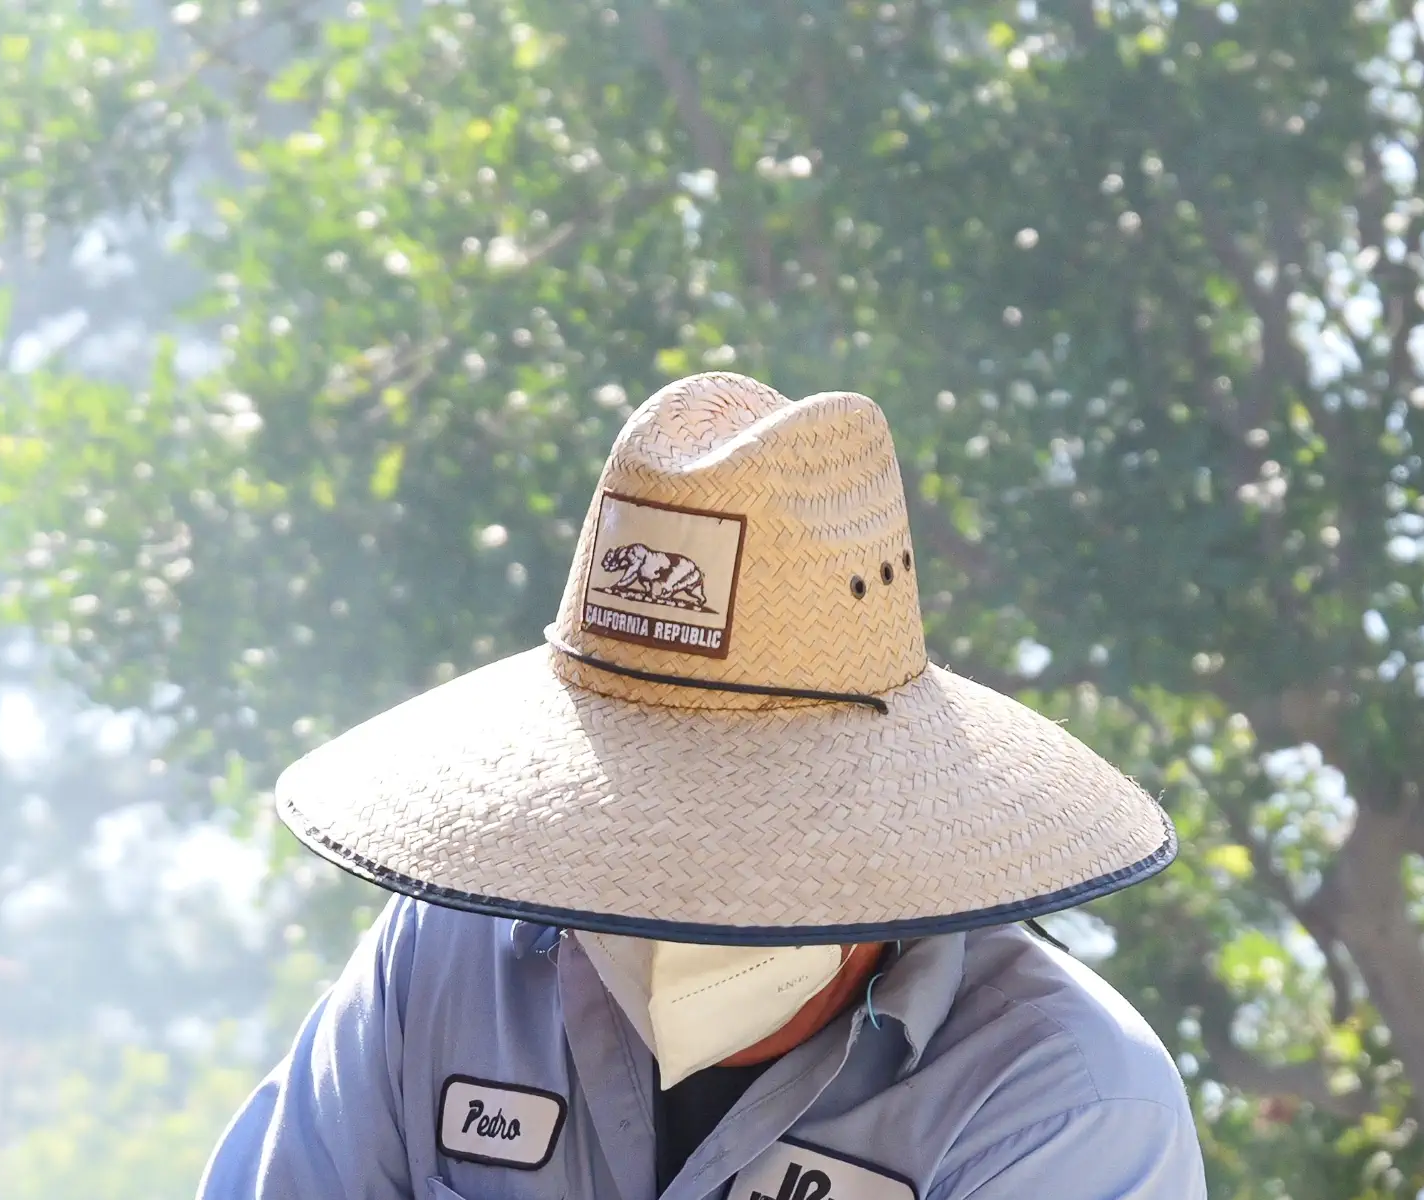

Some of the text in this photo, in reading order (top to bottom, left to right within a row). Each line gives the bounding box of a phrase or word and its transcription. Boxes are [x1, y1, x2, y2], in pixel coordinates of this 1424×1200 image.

[585, 604, 722, 649] CALIFORNIA REPUBLIC
[461, 1099, 521, 1141] Pedro
